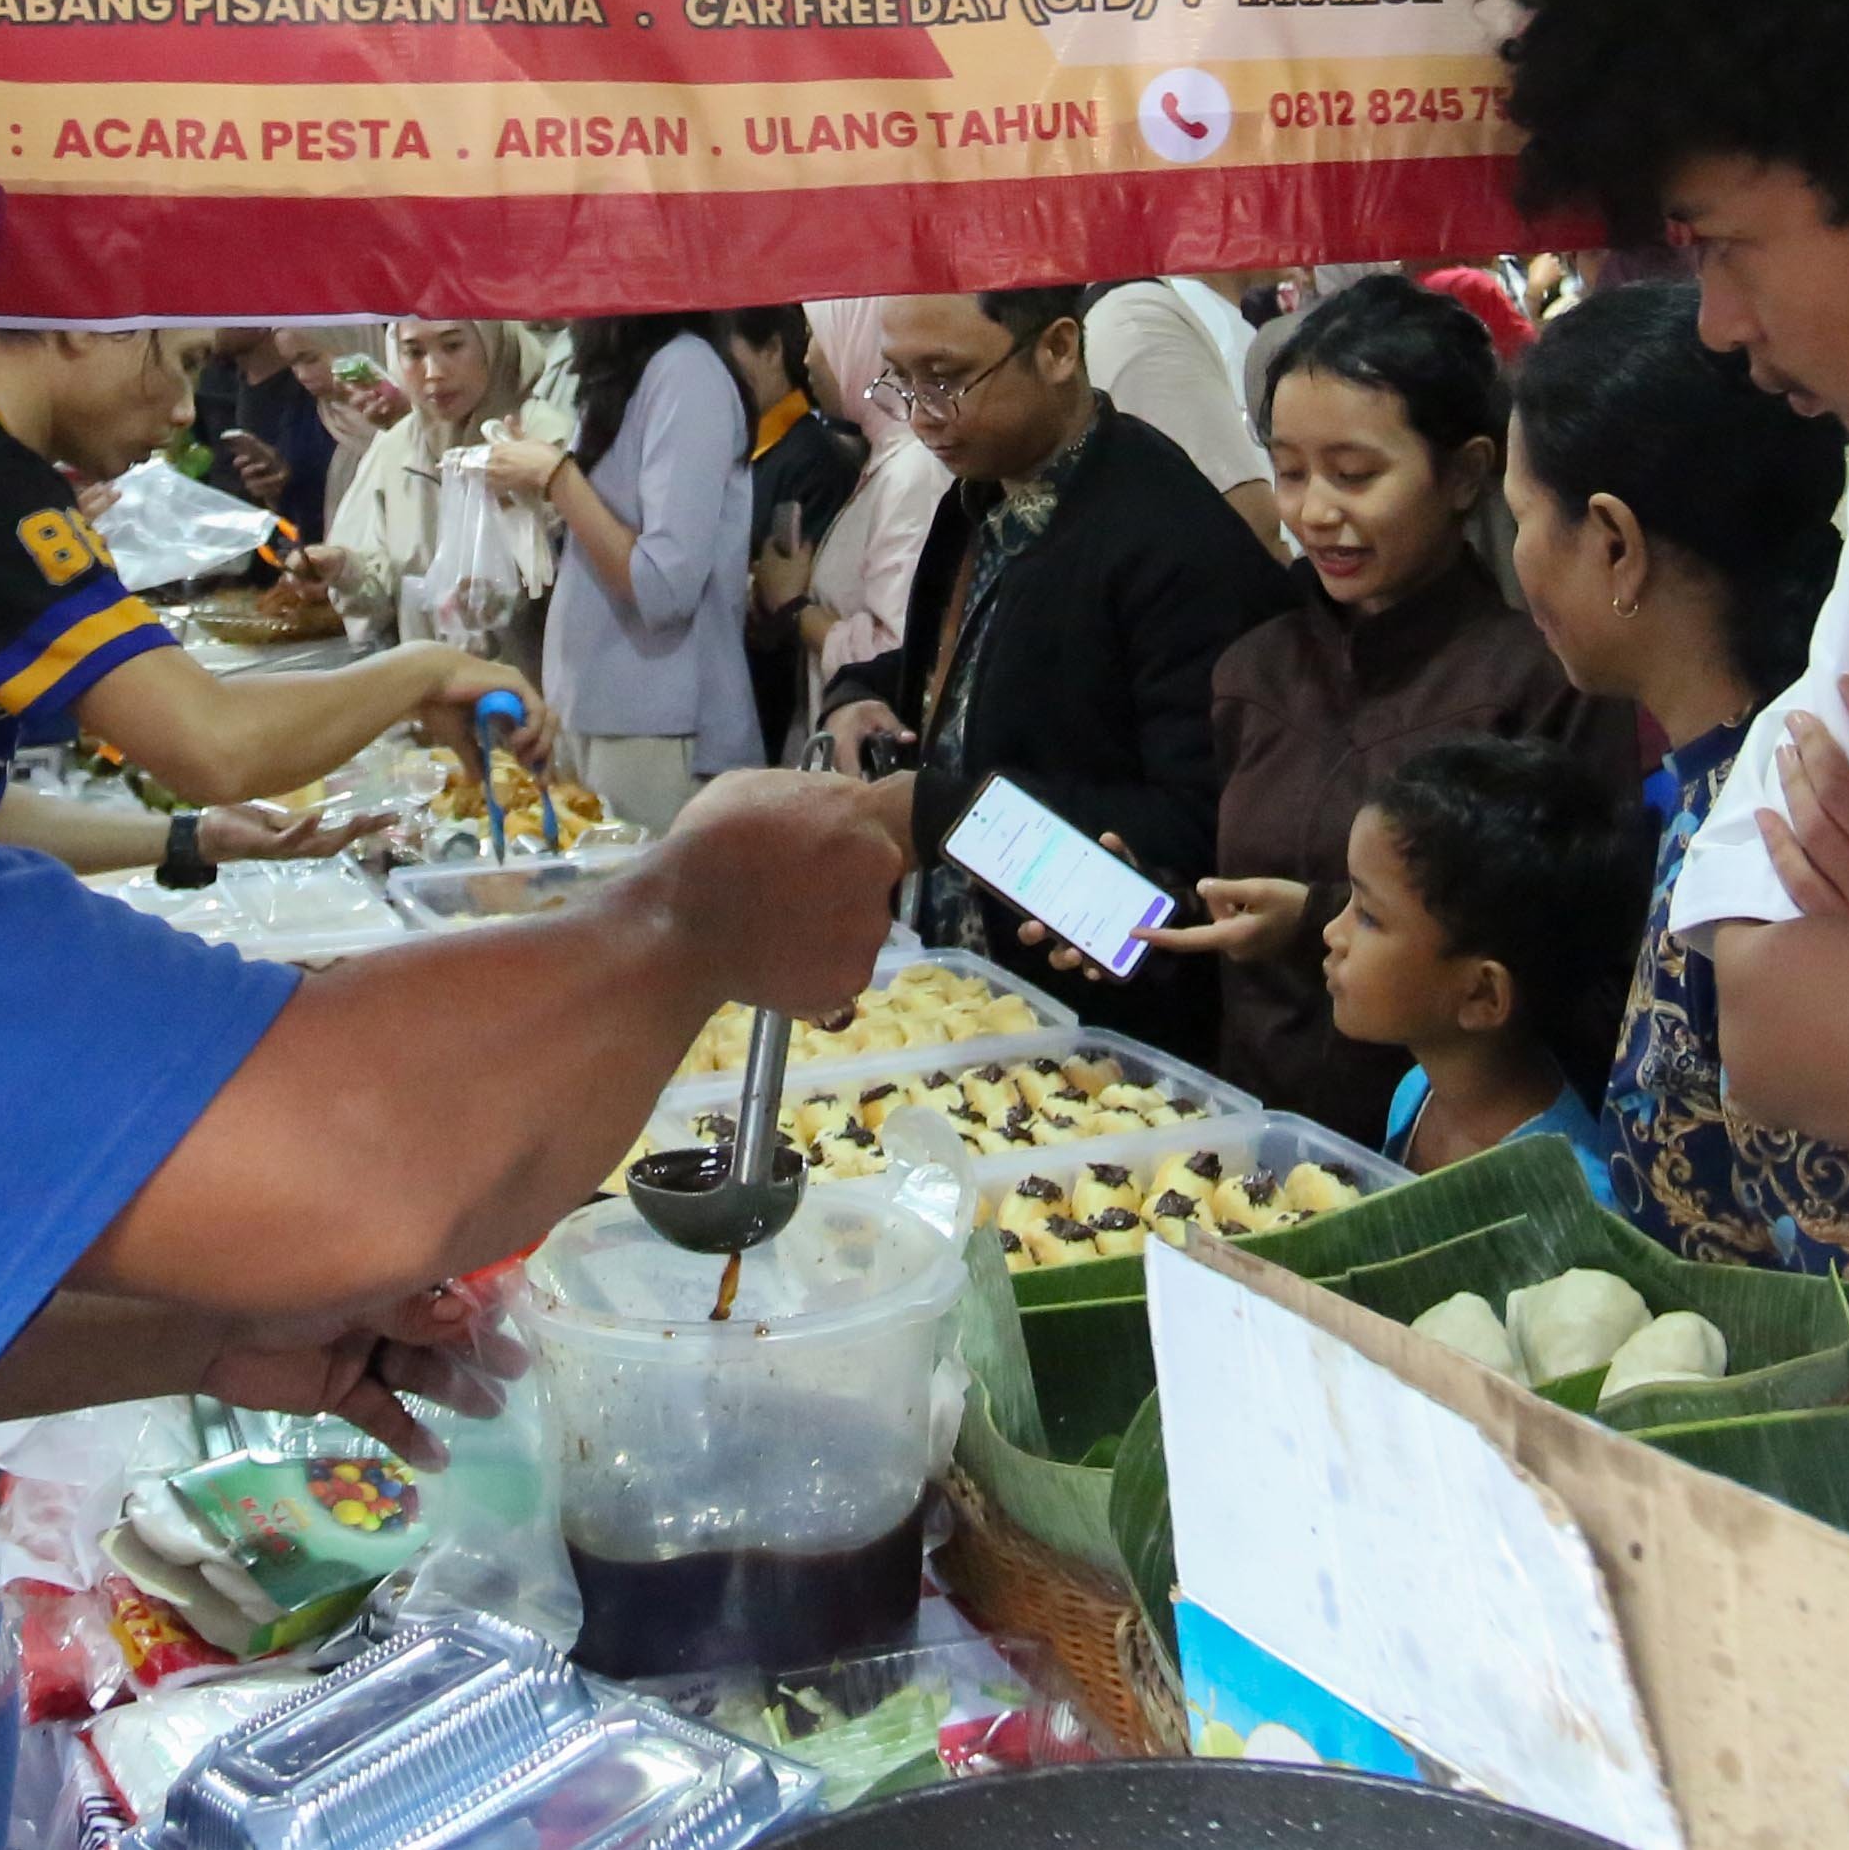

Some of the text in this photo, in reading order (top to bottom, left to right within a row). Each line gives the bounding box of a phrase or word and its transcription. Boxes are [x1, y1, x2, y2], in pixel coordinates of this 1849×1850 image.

[52, 118, 247, 162] ACARA
[262, 119, 429, 162] PESTA
[494, 116, 688, 162] ARISAN
[744, 111, 919, 156] ULANG
[927, 99, 1098, 146] TAHUN
[1270, 90, 1356, 130] 0812
[1367, 87, 1464, 124] 8245
